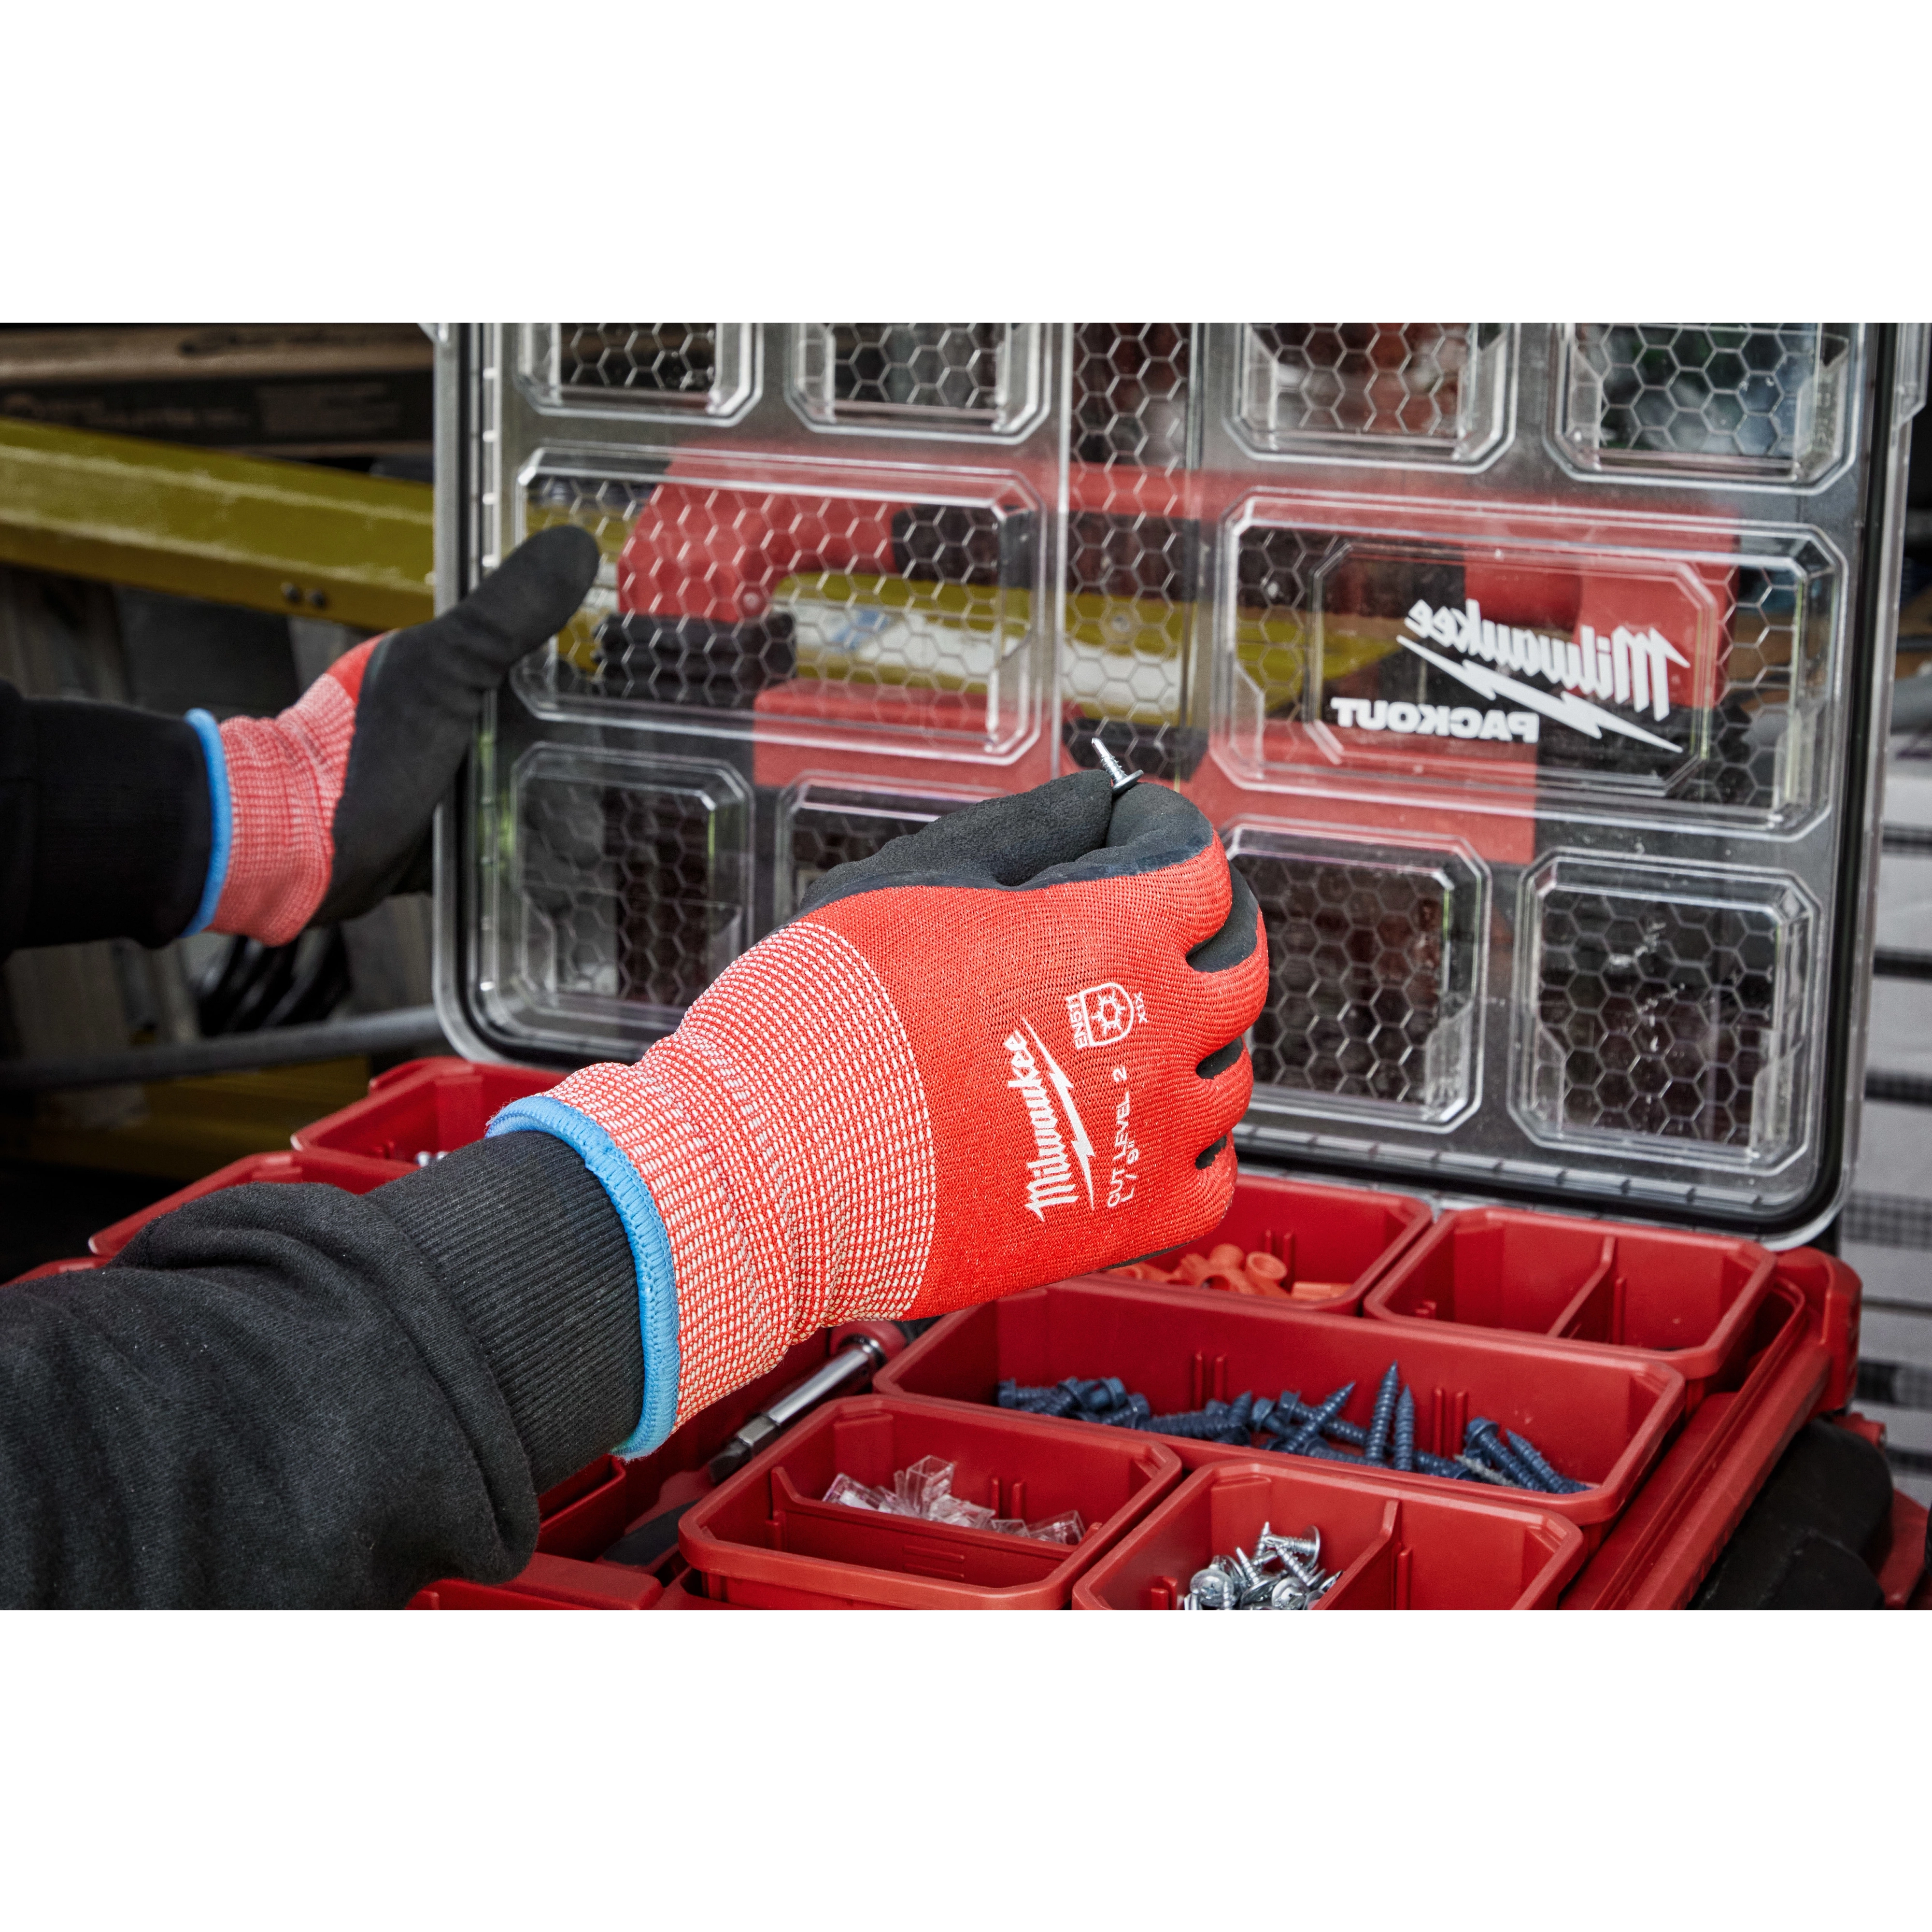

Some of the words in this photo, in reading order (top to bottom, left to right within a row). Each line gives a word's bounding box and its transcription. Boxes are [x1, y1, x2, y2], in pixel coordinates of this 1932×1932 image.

[1066, 995, 1087, 1049] EN511
[1135, 991, 1148, 1024] X1X
[1113, 1065, 1127, 1081] 2
[1004, 1029, 1079, 1222] Milwaukee
[1114, 1091, 1130, 1161] LEVEL
[1108, 1168, 1124, 1208] CUT
[1121, 1187, 1135, 1203] L
